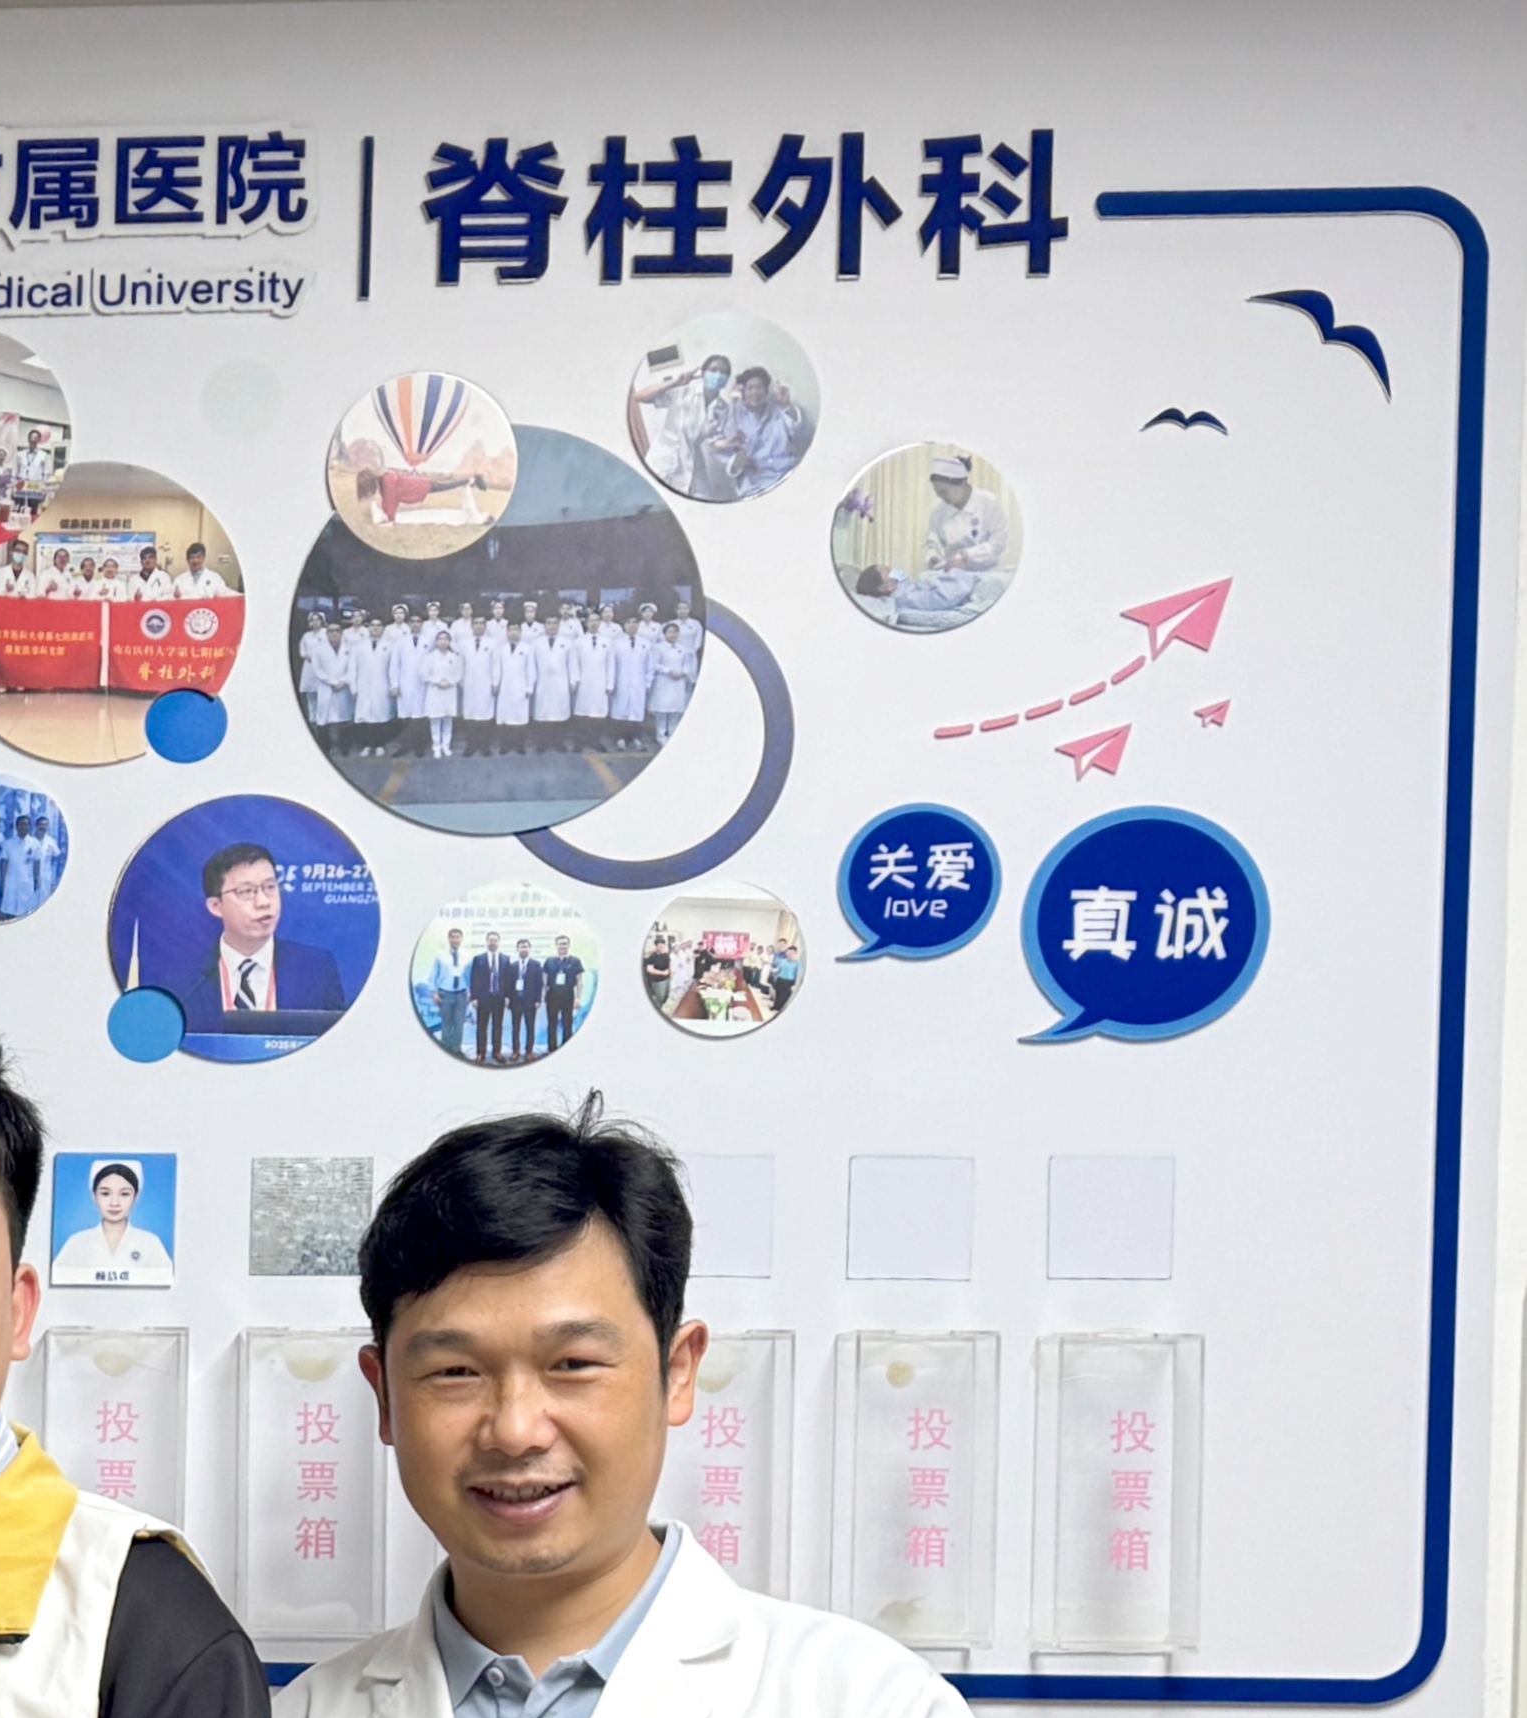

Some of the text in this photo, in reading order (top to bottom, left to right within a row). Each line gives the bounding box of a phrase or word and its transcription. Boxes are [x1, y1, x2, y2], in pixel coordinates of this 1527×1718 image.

[423, 129, 1069, 286] 脊柱外科
[98, 273, 306, 311] University
[867, 841, 975, 891] 关爱
[883, 896, 949, 919] love
[1062, 885, 1231, 962] 真诚
[296, 1402, 342, 1560] 投票箱
[699, 1405, 745, 1566] 投票箱
[905, 1406, 952, 1570] 投票箱
[1108, 1409, 1157, 1573] 投票箱
